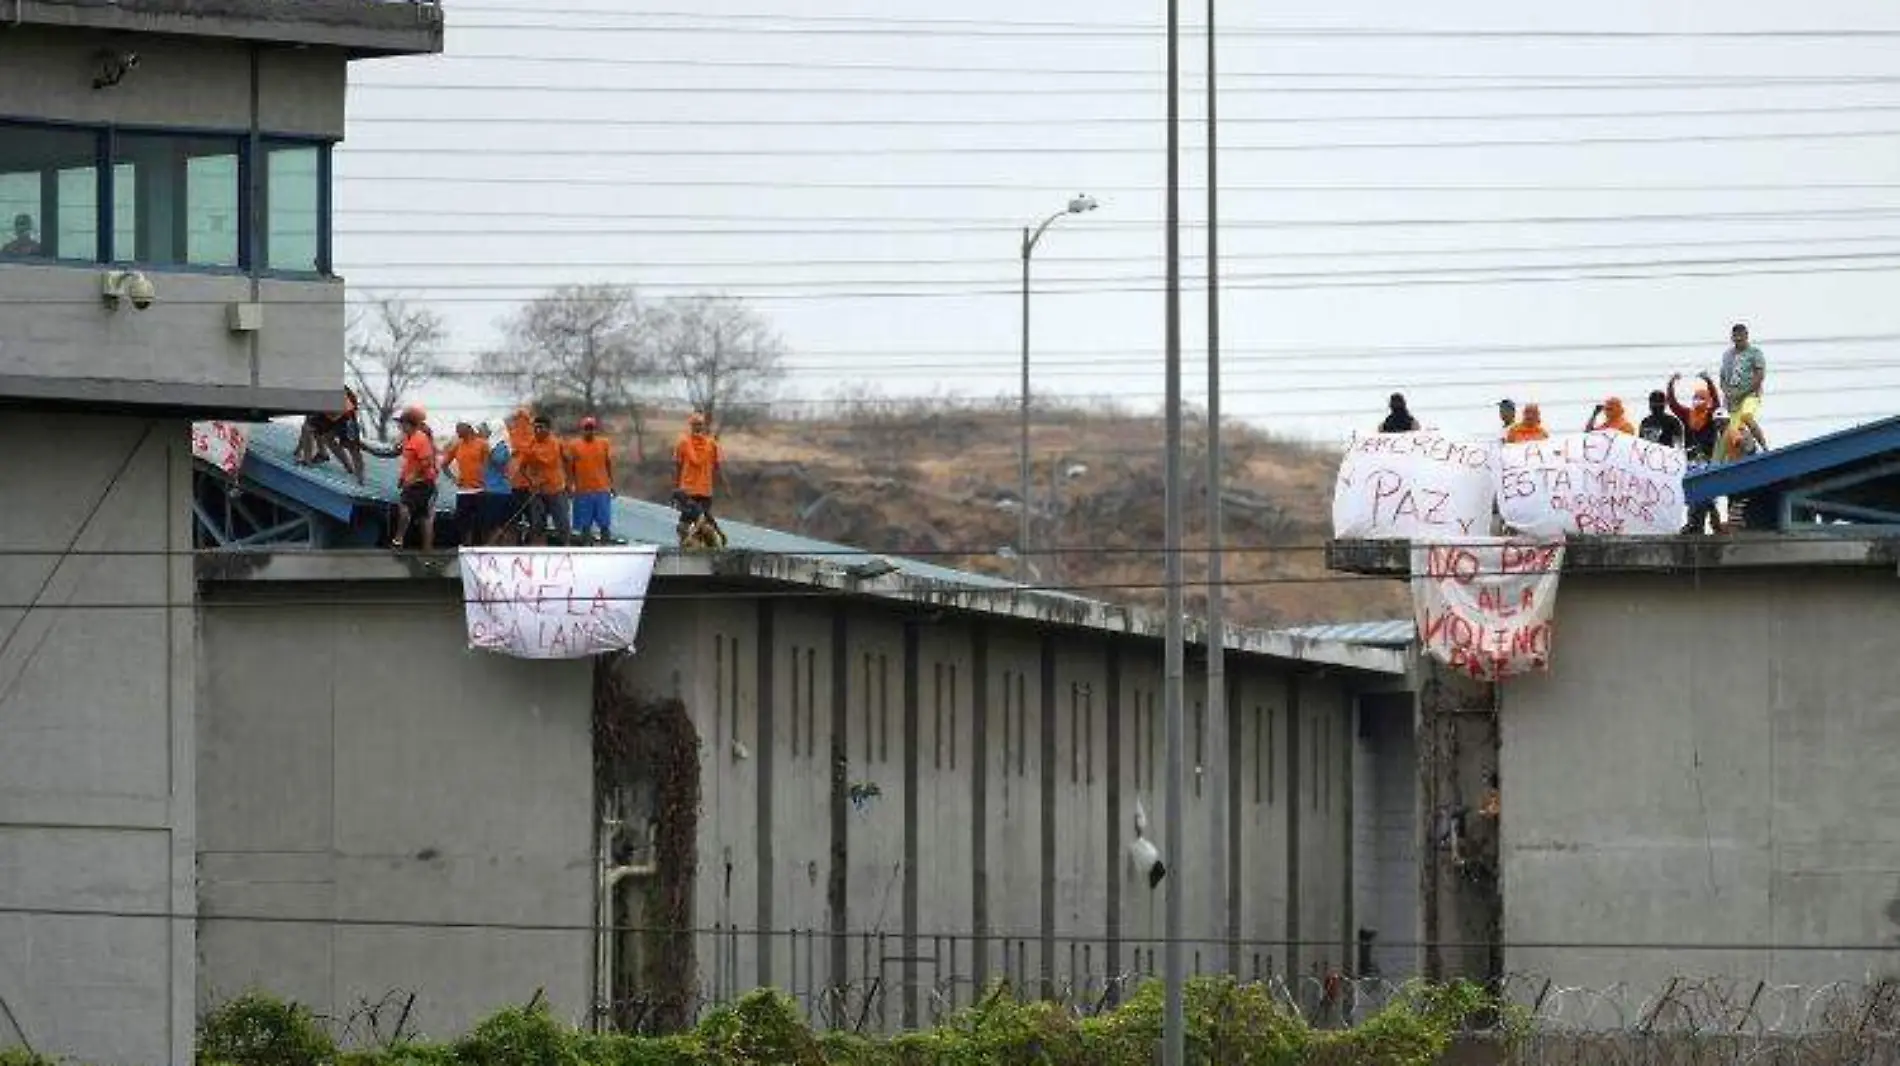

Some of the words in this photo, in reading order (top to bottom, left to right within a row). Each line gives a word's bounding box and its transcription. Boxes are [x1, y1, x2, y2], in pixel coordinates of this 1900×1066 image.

[1365, 468, 1451, 528] PAZ
[1457, 519, 1475, 535] Y
[1428, 544, 1478, 585] NO
